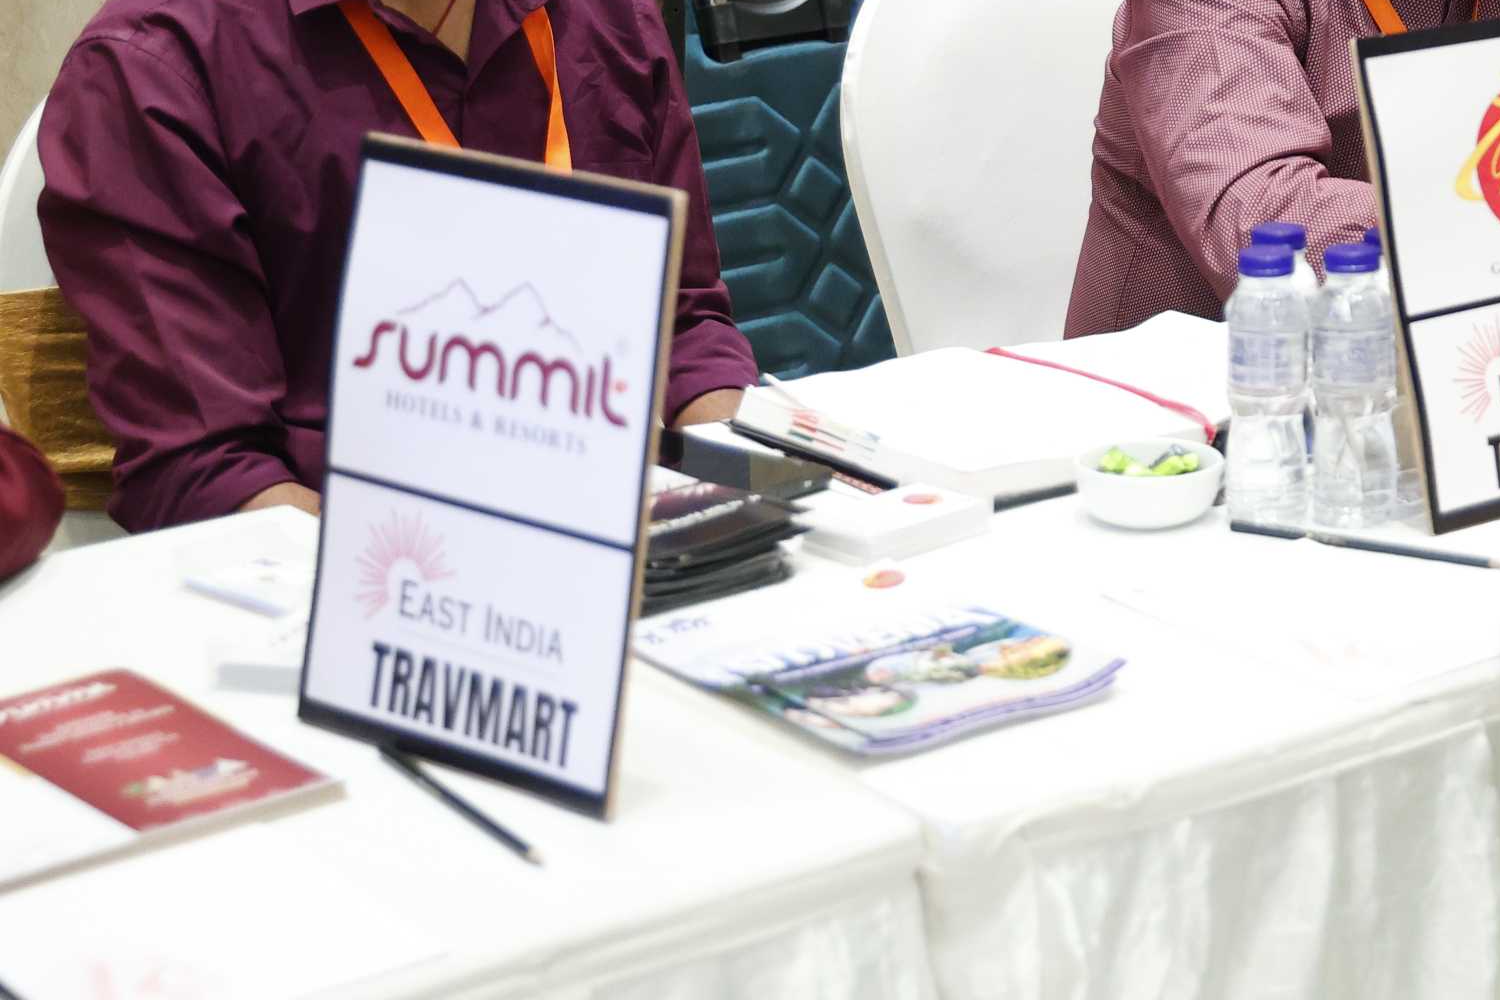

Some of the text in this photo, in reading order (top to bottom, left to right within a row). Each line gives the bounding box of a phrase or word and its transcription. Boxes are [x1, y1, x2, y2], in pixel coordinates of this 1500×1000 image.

[386, 391, 587, 455] HOTELS & RESORTS
[399, 578, 565, 663] EAST INDIA
[369, 640, 579, 768] TRAVMART
